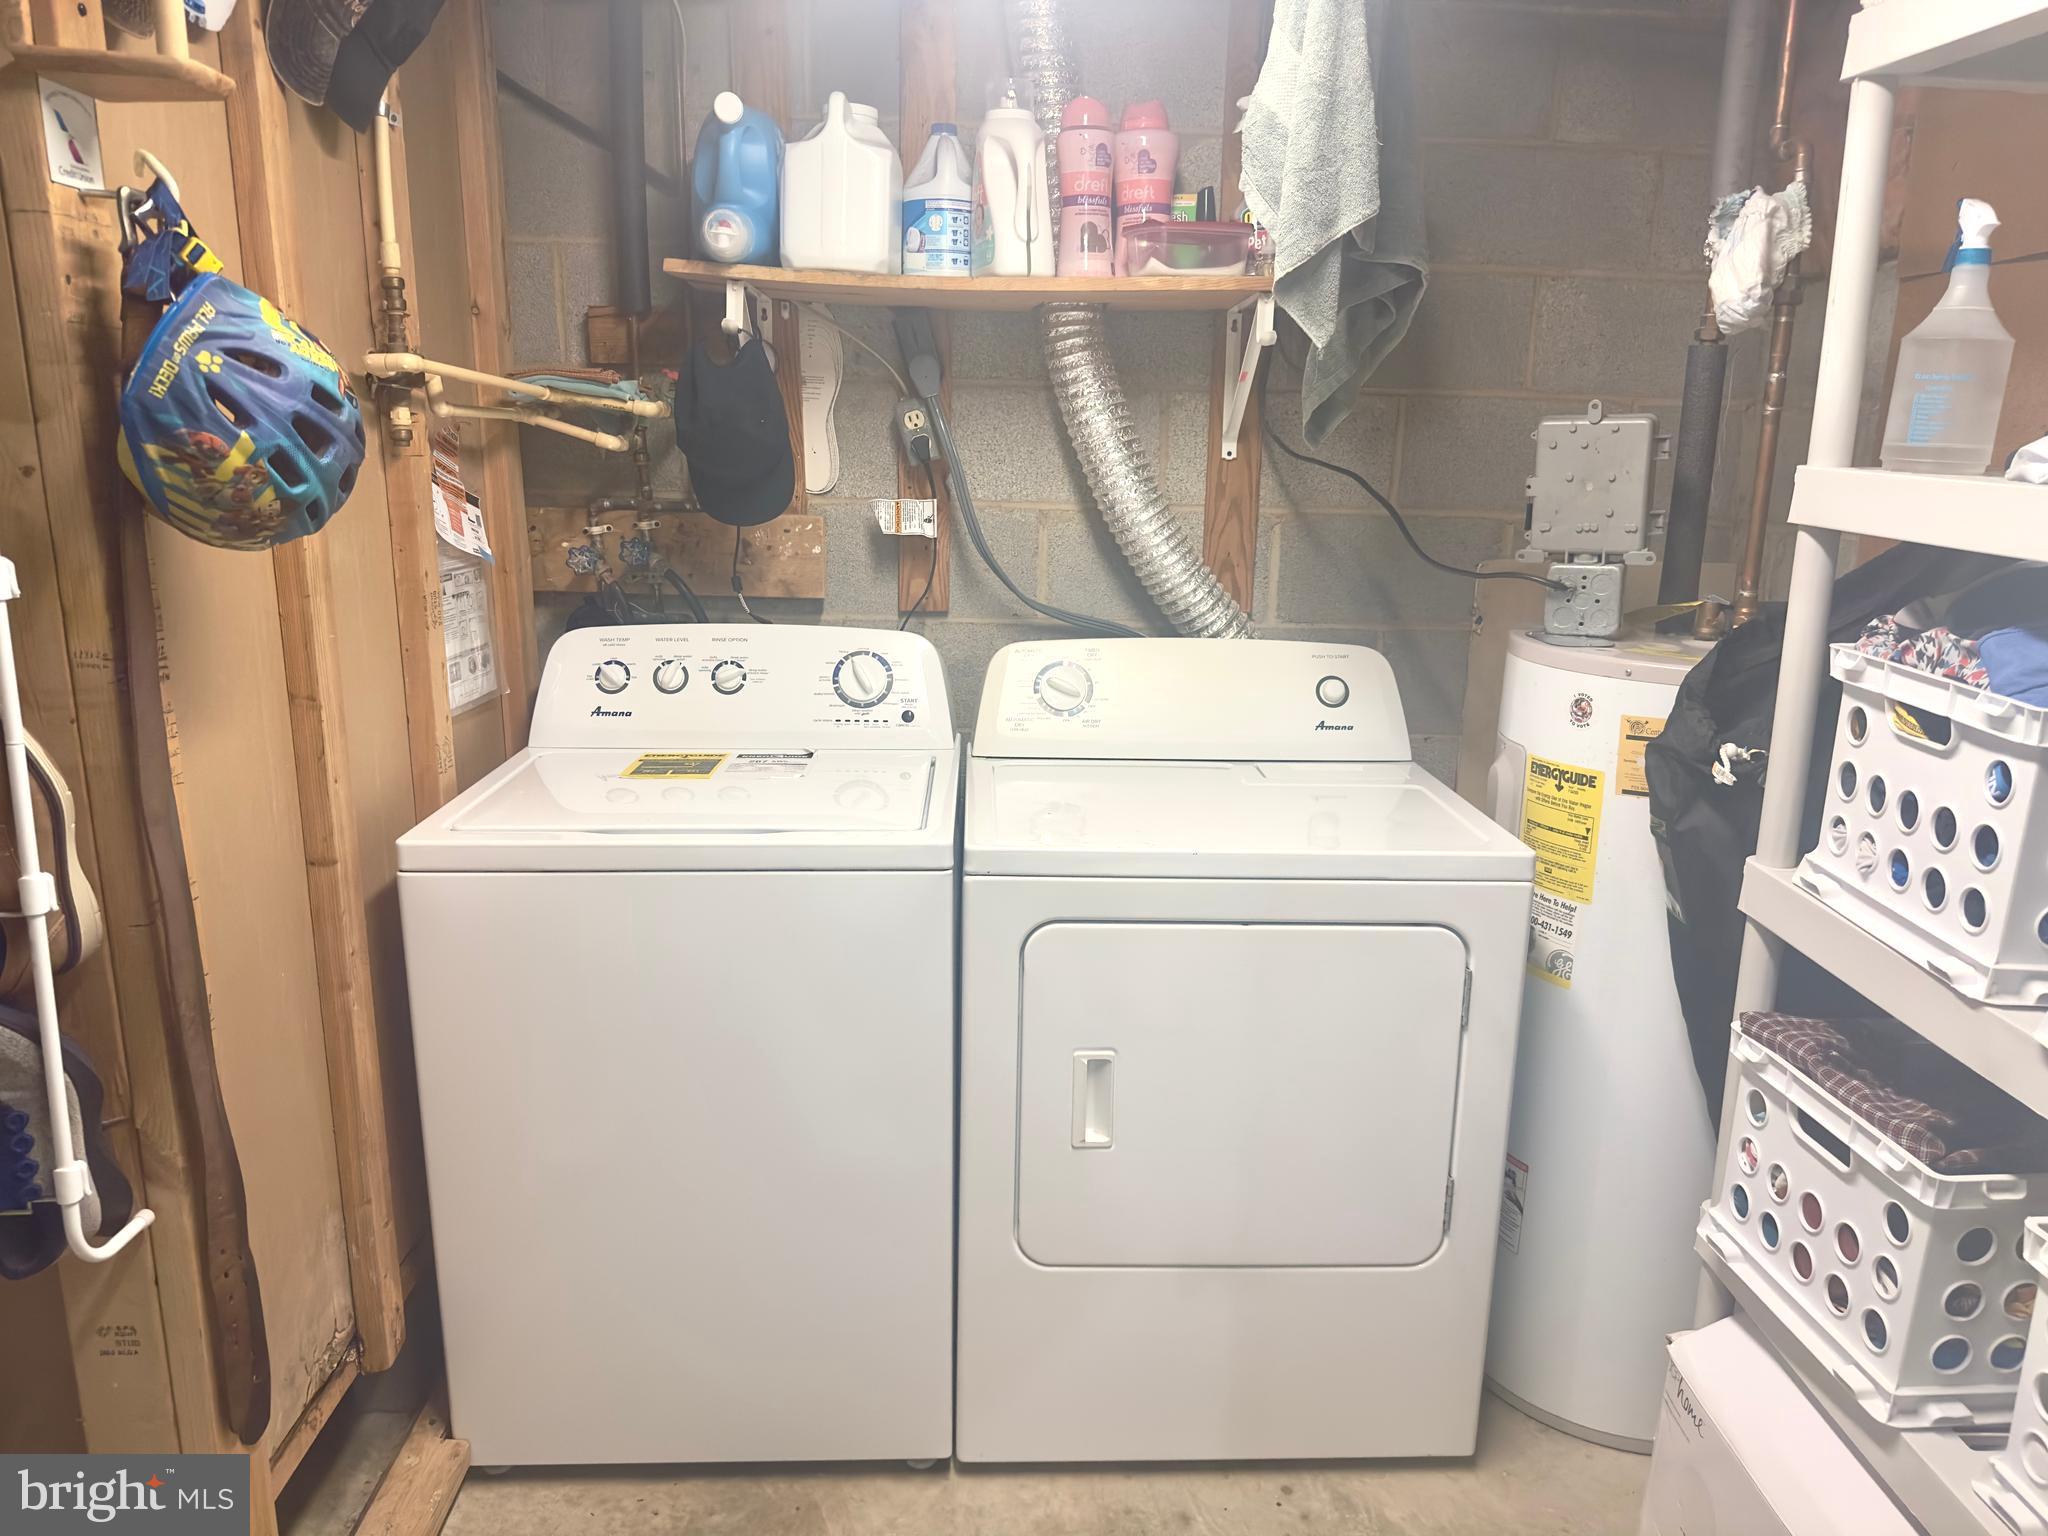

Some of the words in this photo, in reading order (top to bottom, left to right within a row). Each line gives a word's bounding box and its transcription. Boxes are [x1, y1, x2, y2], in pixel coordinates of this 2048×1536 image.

[1121, 184, 1155, 200] dreft
[199, 301, 217, 325] ALL
[173, 321, 206, 356] PAWS
[148, 358, 180, 400] DECK!
[590, 706, 632, 717] Amana
[1315, 720, 1354, 731] Amana
[1530, 761, 1597, 790] ENERGYGUIDE
[1539, 893, 1552, 905] Here
[1552, 898, 1560, 907] To
[1560, 902, 1577, 913] Help!
